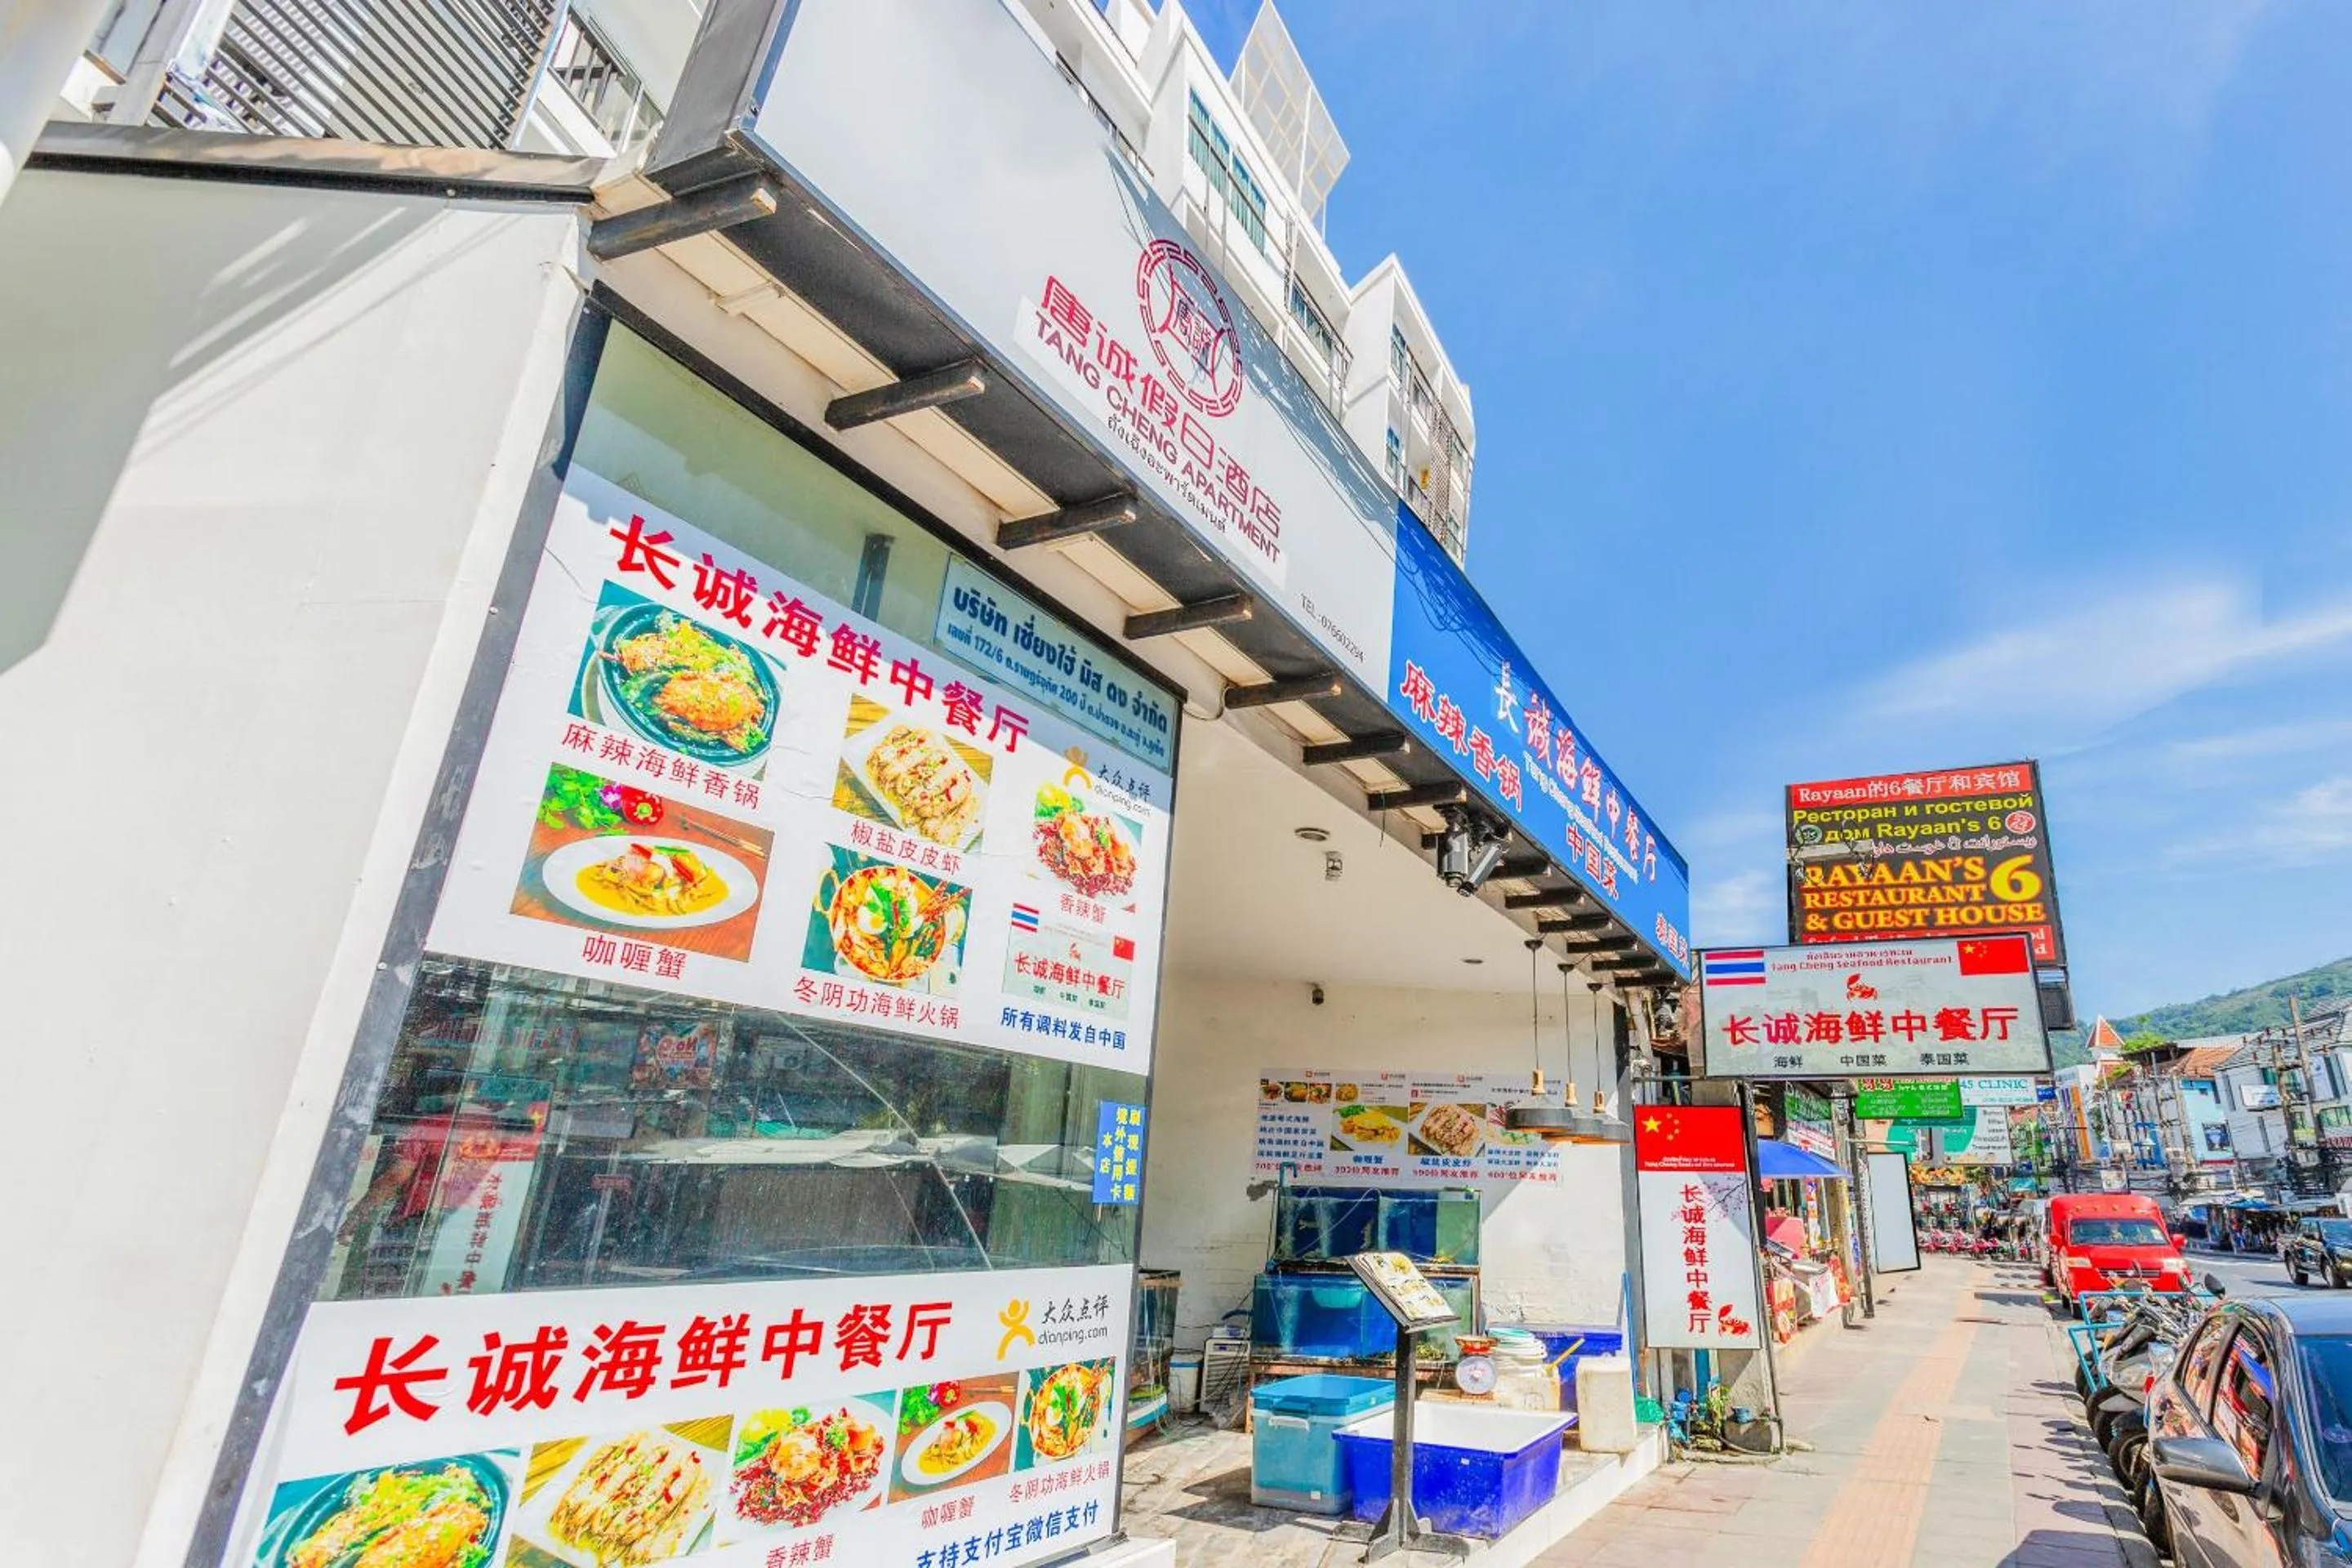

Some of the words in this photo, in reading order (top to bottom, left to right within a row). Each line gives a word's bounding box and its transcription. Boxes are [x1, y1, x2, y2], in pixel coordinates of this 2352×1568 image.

[1041, 274, 1281, 541] 唐诚假日酒店
[1036, 310, 1100, 390] TANG
[1107, 385, 1178, 465] CHENG
[1181, 461, 1281, 564] APARTMENT
[608, 514, 1030, 754] 长诚海鲜中餐厅
[953, 586, 1007, 637] บริษัท
[1132, 690, 1167, 734] จำกัด
[974, 635, 1003, 664] 172/6
[1059, 684, 1078, 706] 200
[1400, 661, 1523, 813] 麻辣香锅
[562, 721, 761, 811] 麻辣海鲜香锅
[1793, 806, 1897, 824] Ресторан
[1904, 804, 1918, 817] и
[1925, 793, 2034, 815] гостевой
[1877, 818, 1981, 840] Rayaan's
[1987, 816, 2002, 831] 6
[851, 821, 964, 875] 椒盐皮皮虾
[1803, 856, 1987, 889] RAYAAN'S
[1990, 854, 2042, 902] 6
[1803, 884, 1987, 910] RESTAURANT
[1059, 893, 1106, 924] 香辣蟹
[1805, 913, 1828, 932] &
[1832, 906, 1935, 931] GUEST
[1936, 902, 2047, 926] HOUSE
[582, 933, 686, 983] 咖喱蟹
[1014, 951, 1125, 1000] 长诚海鲜中餐厅
[792, 976, 961, 1029] 冬阴功海鲜火锅
[1722, 1007, 2019, 1046] 长诚海鲜中餐厅
[1001, 1006, 1126, 1051] 所有调料发自中国
[1774, 1054, 1803, 1069] 海鲜
[1840, 1053, 1888, 1067] 中国菜
[1978, 1079, 2029, 1089] CLINIC
[1679, 1183, 1712, 1334] 长诚海鲜中餐厅
[1042, 1294, 1110, 1325] 大众点评
[1037, 1325, 1108, 1347] dianping.com
[334, 1301, 952, 1437] 长诚海鲜中餐厅
[1009, 1460, 1111, 1503] 冬阴功海鲜火锅
[915, 1501, 1099, 1568] 支持支付宝微信支付
[920, 1495, 975, 1530] 咖喱蟹
[766, 1533, 835, 1568] 香辣蟹
